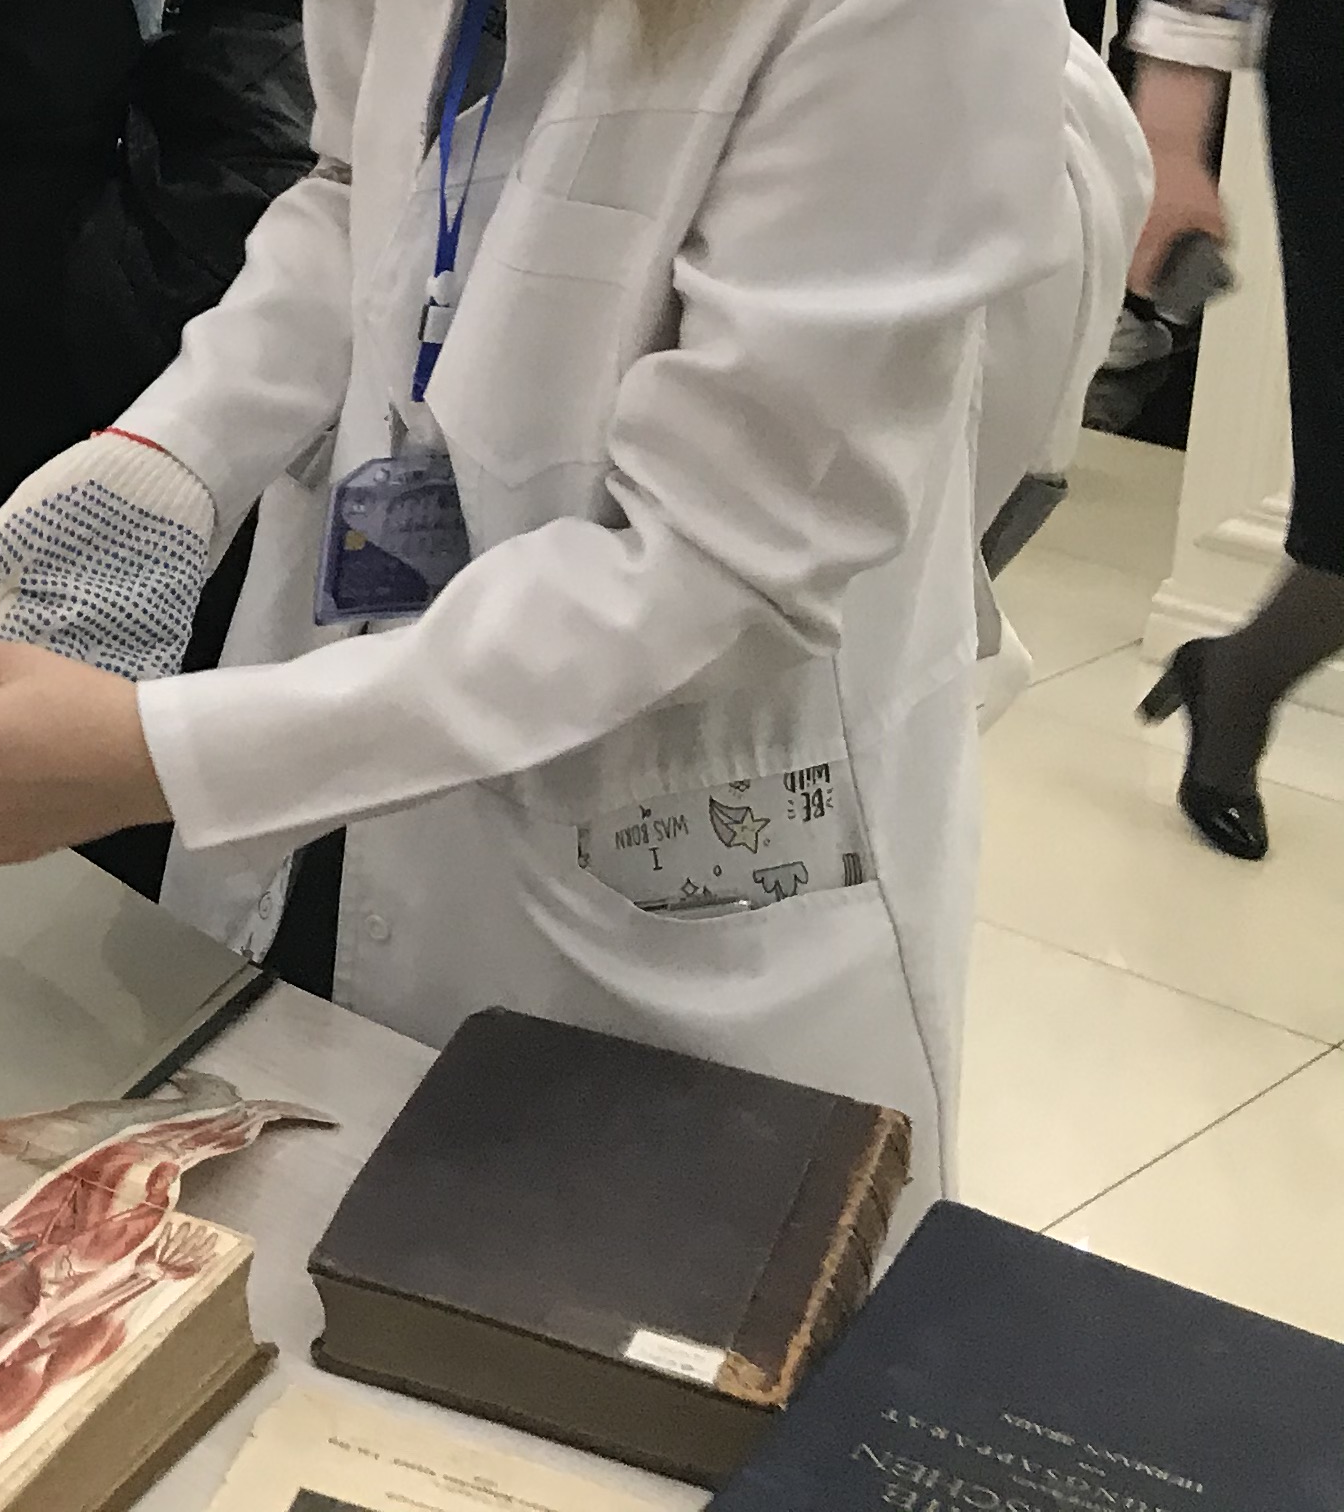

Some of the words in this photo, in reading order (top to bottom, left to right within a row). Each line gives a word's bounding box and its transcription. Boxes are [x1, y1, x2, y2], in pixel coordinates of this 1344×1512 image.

[801, 788, 827, 822] BE
[614, 825, 650, 851] BORN
[653, 814, 690, 843] WAS
